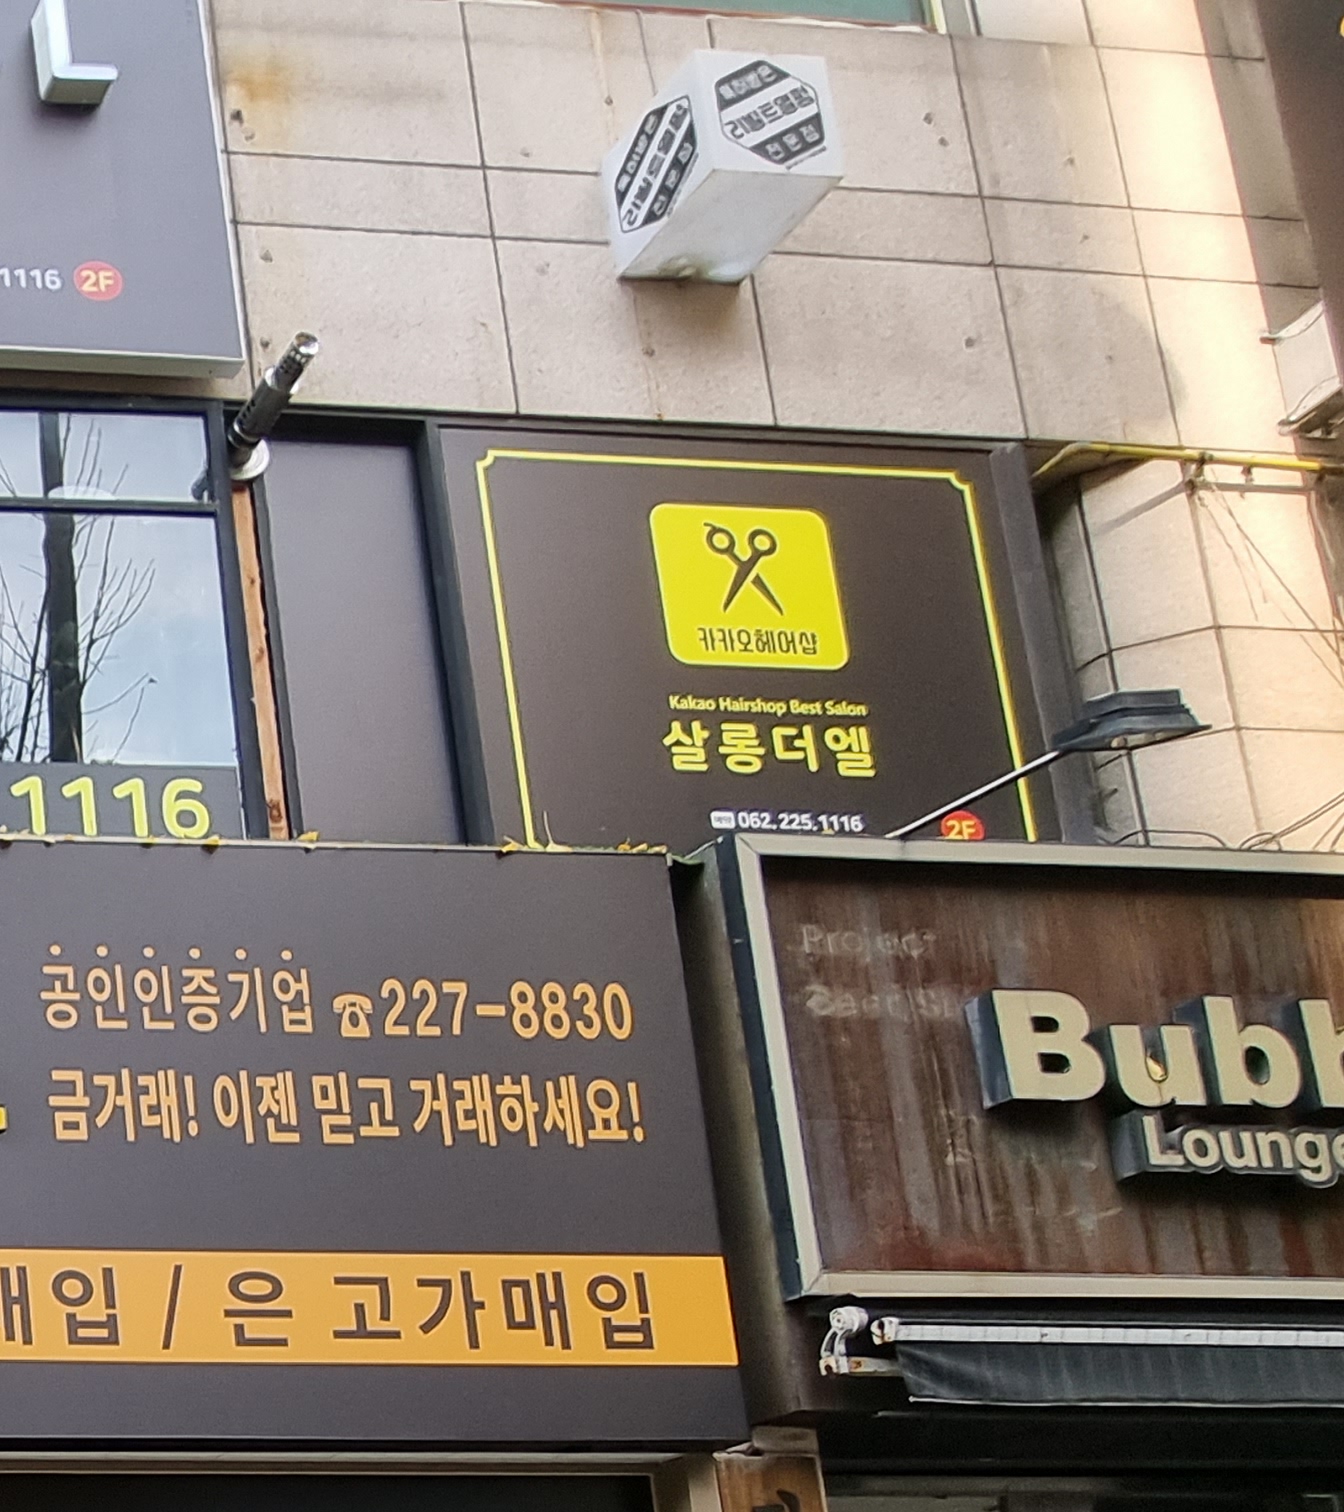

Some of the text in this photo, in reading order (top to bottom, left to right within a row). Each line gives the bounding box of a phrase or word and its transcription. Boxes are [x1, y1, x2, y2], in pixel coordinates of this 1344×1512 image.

[32, 0, 118, 98] L
[80, 269, 116, 292] 2F
[698, 627, 818, 655] 카카오헤어샵
[669, 695, 868, 717] Kakao Hairshop Best Salon
[662, 719, 877, 778] 살롱더엘
[9, 774, 212, 839] 1116
[737, 810, 863, 832] 062.225.1116
[946, 819, 976, 839] 2F
[40, 945, 634, 1040] 공인인증기업 227-8830
[48, 1067, 645, 1148] 금거래! 이젠 믿고 거래하세요!
[223, 1269, 293, 1347] 은
[331, 1270, 657, 1350] 고가매입
